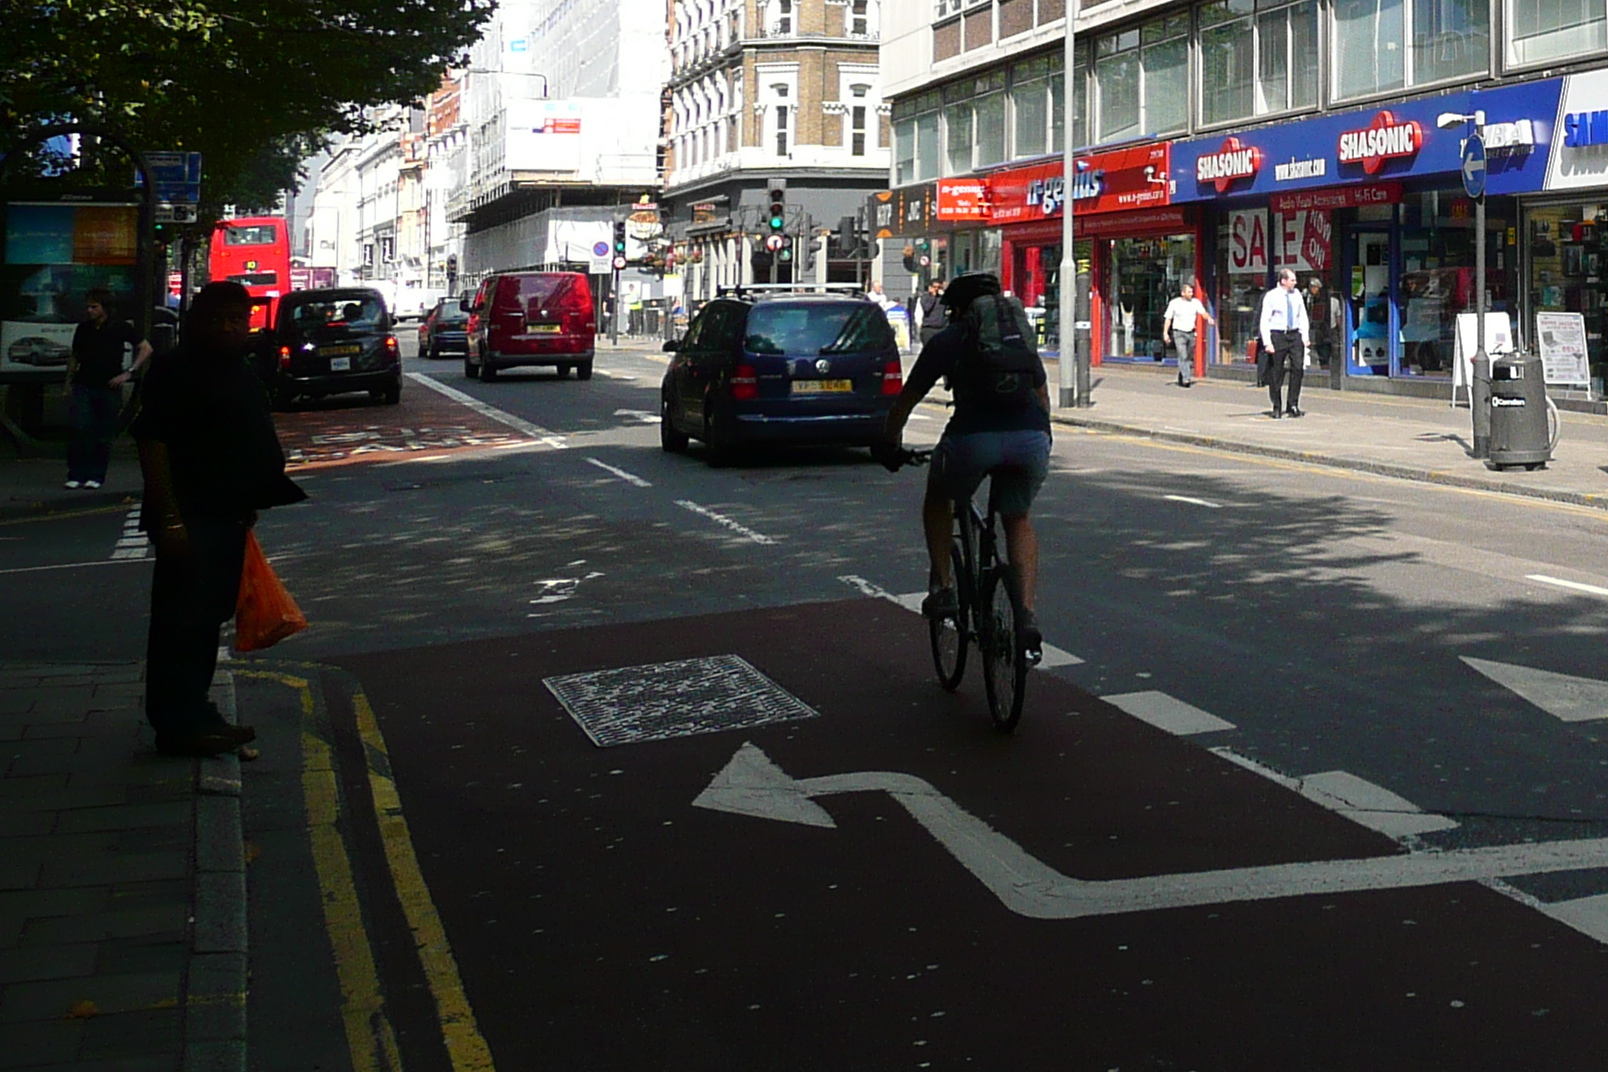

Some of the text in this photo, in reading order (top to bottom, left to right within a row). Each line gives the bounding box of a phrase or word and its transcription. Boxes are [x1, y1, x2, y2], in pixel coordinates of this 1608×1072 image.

[1340, 125, 1414, 161] SHASONIC
[1197, 149, 1254, 181] SHASONIC
[1275, 156, 1326, 181] www.shasonic.com
[1354, 187, 1388, 201] Hi-Fi Care
[1232, 211, 1298, 269] SALE
[1310, 208, 1332, 243] NOW
